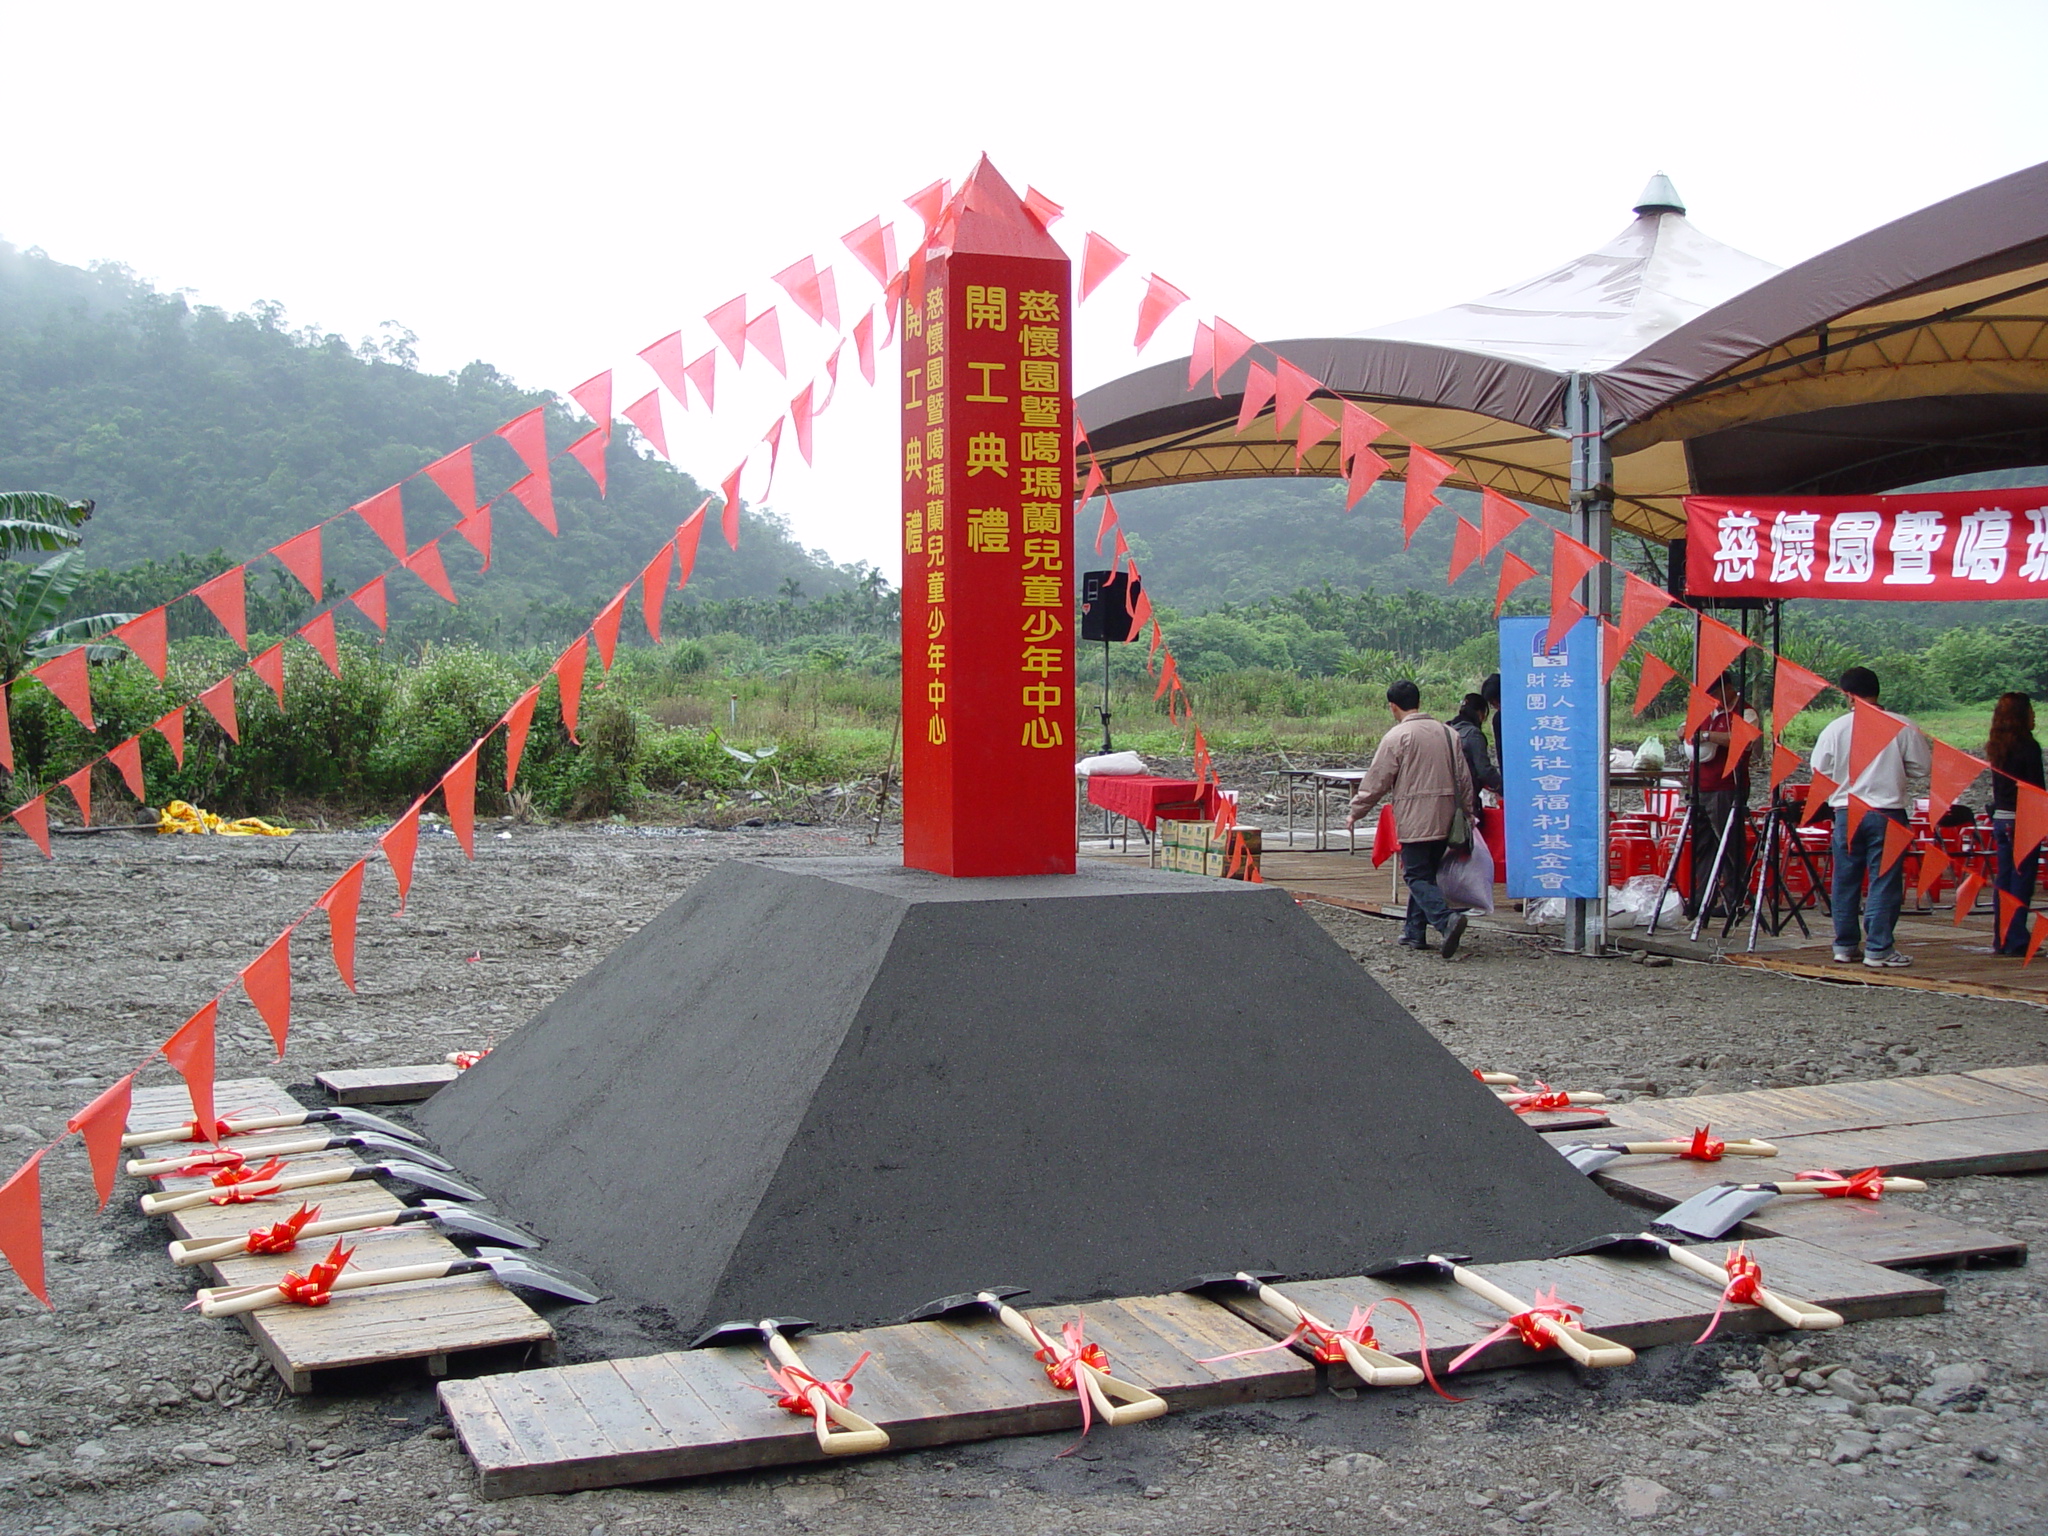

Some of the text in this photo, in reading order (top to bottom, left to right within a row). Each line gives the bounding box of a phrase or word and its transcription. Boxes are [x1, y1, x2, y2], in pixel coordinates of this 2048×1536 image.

[925, 286, 947, 746] 慈懷園暨噶瑪蘭兒童少年中心
[965, 285, 1010, 553] 開工典禮
[1018, 289, 1063, 749] 慈懷園暨噶瑪蘭兒童少年中心
[1529, 715, 1572, 889] 慈懷社會福利基金會
